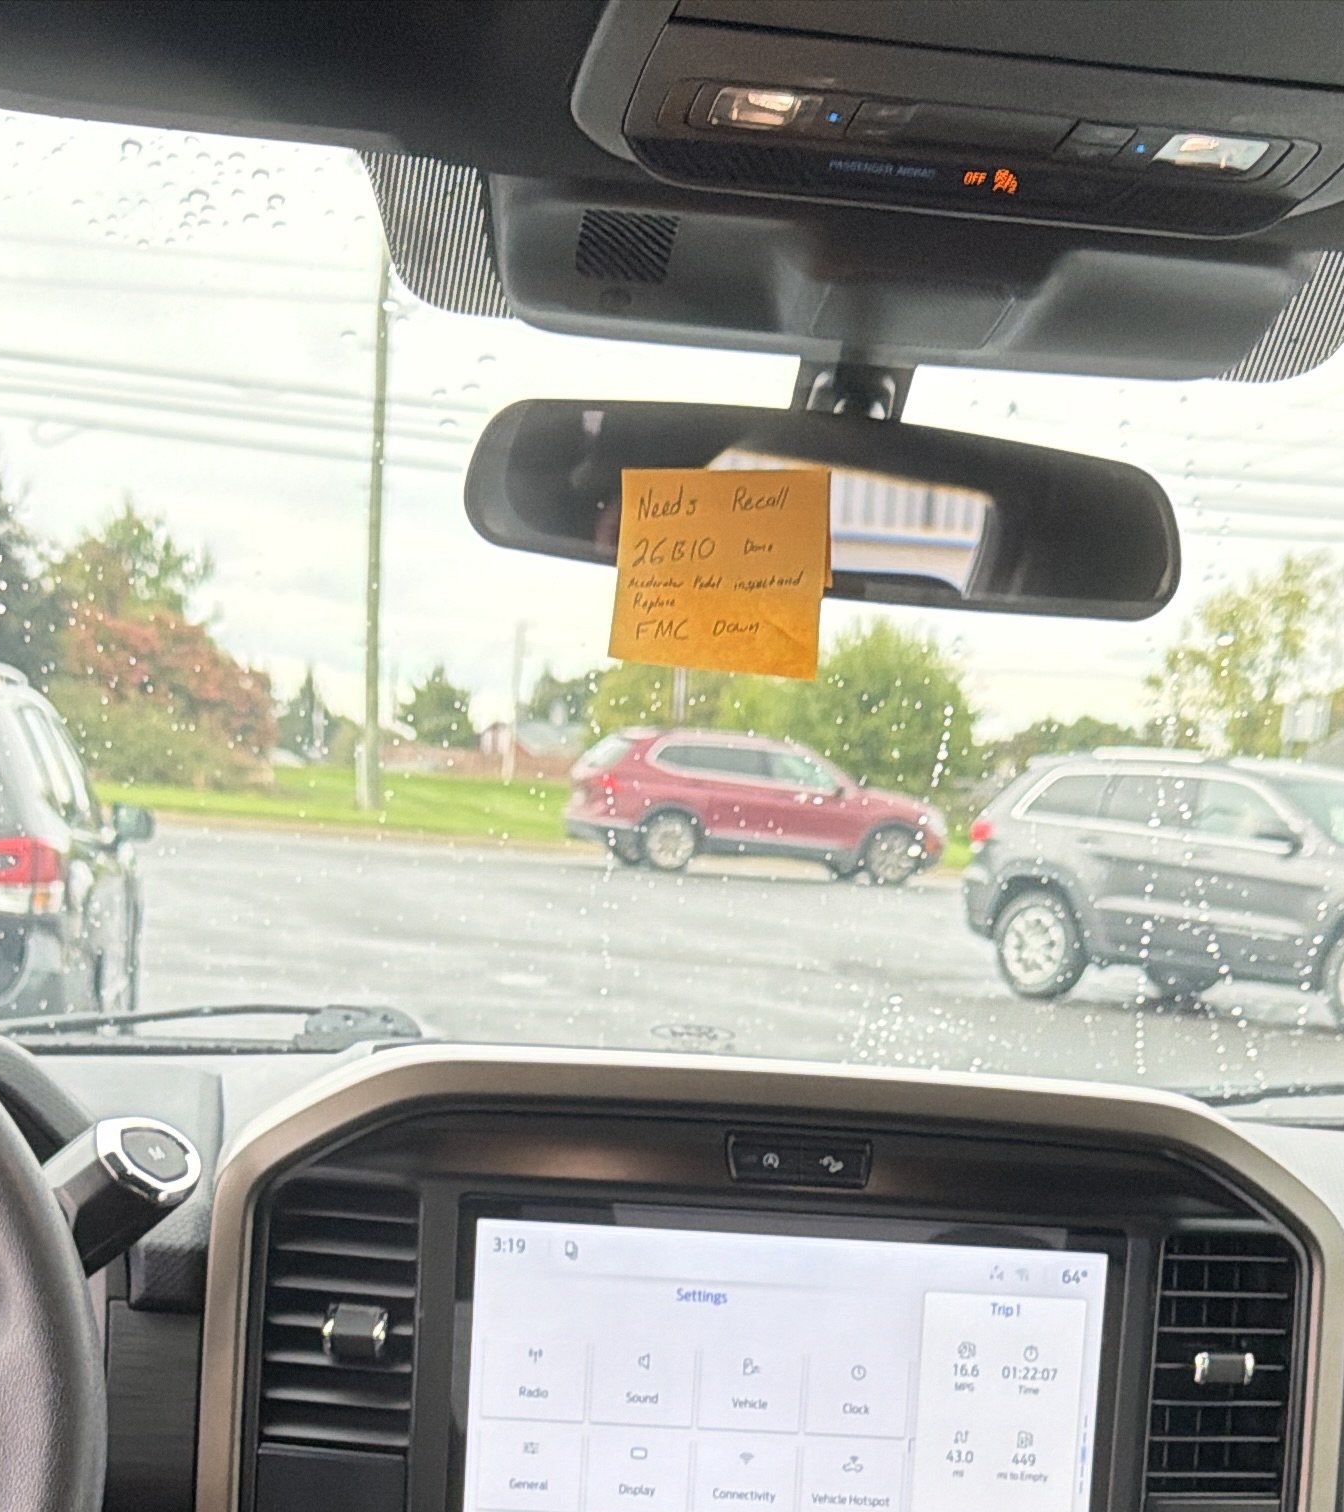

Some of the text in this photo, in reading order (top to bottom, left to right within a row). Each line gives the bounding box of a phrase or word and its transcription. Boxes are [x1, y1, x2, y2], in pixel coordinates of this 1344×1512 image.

[963, 171, 988, 186] OFF
[637, 484, 789, 521] Needs Recall
[635, 618, 688, 640] FMC
[492, 1236, 526, 1254] 3:19
[675, 1287, 729, 1306] Settings
[990, 1302, 1014, 1319] Trip
[952, 1363, 1058, 1382] 16.6 01:22:07
[518, 1385, 549, 1399] Radio
[954, 1382, 975, 1393] MPG
[1017, 1385, 1040, 1396] Time
[625, 1391, 659, 1405] Sound
[731, 1397, 768, 1411] Vehicle
[842, 1403, 870, 1416] Clock
[945, 1450, 974, 1464] 43.0
[1011, 1453, 1036, 1467] 449
[509, 1477, 548, 1491] General
[1019, 1471, 1049, 1484] Empty
[618, 1483, 656, 1498] Display
[712, 1487, 776, 1503] Connectivity
[811, 1493, 890, 1508] Vehicle Hotspot
